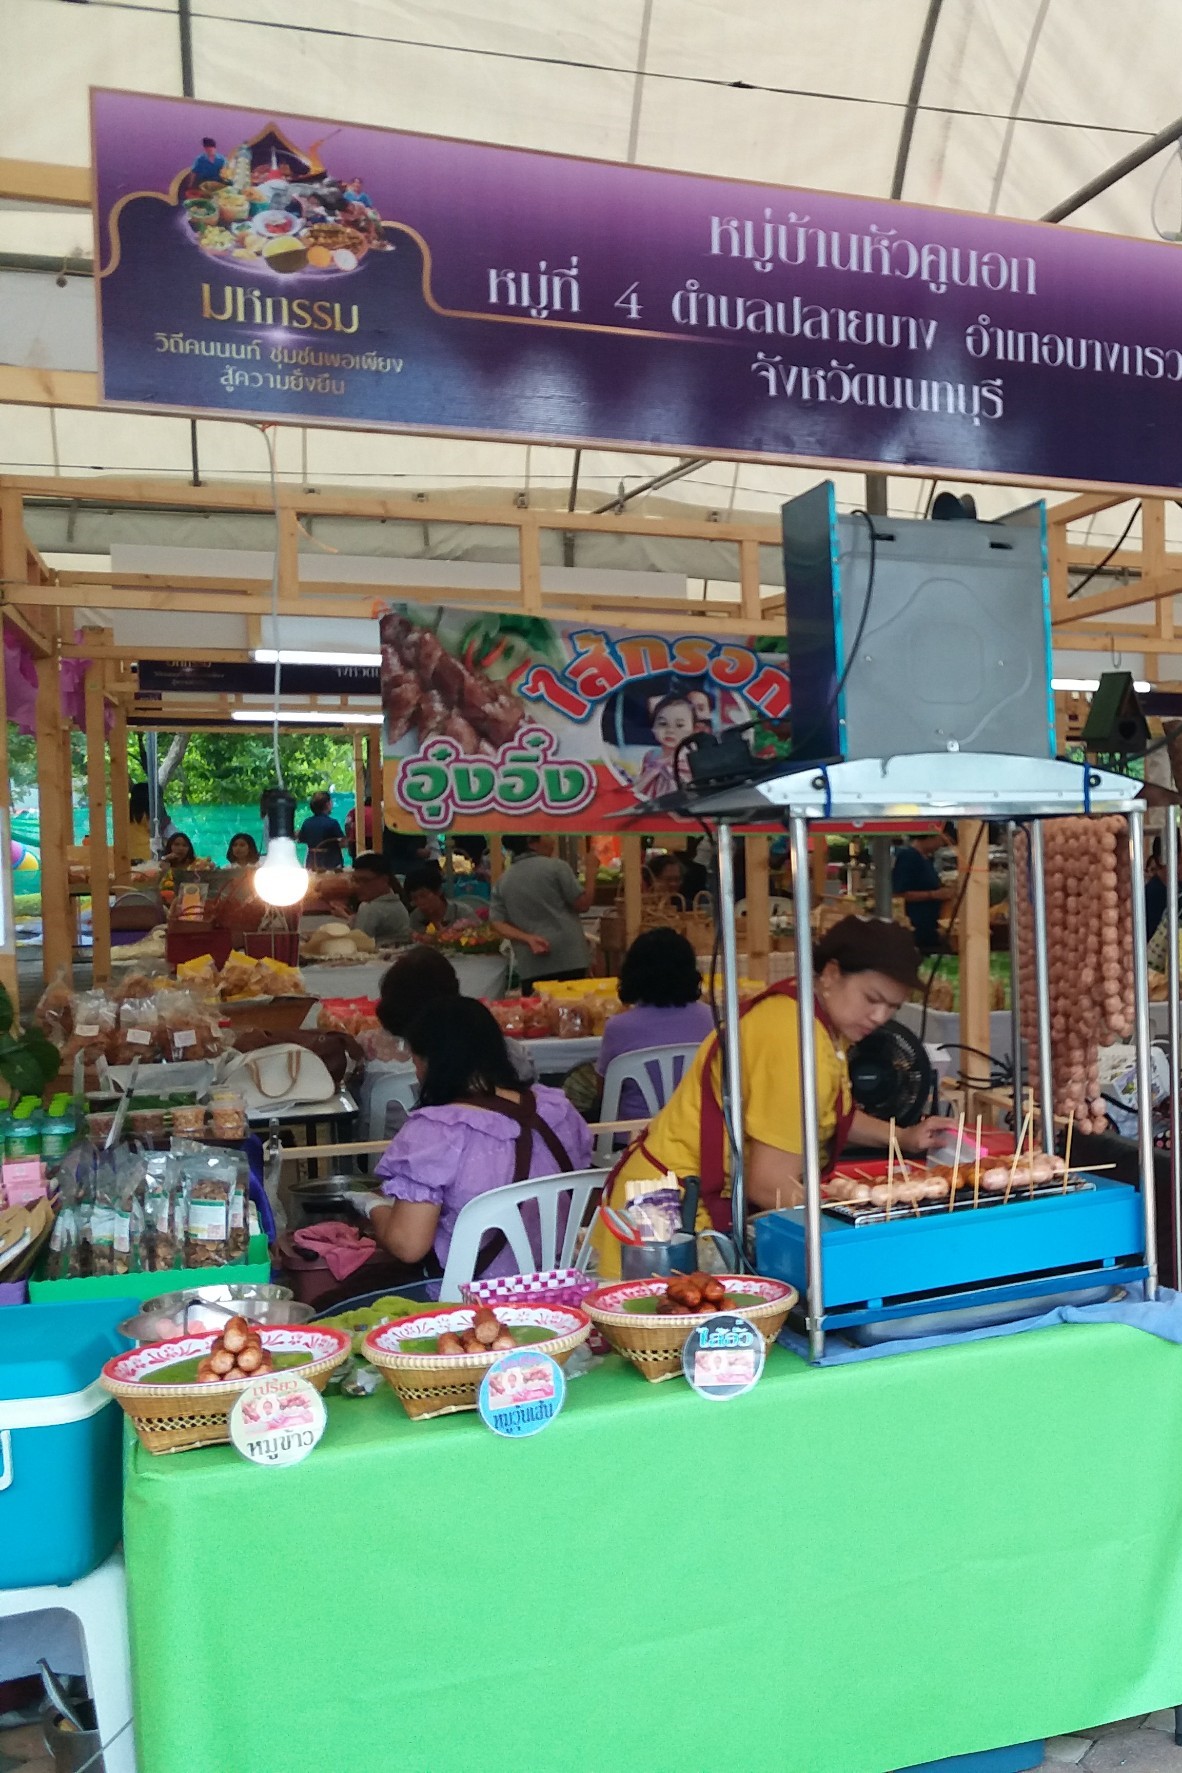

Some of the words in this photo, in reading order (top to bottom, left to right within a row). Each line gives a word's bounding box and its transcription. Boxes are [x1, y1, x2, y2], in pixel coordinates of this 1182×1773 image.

[710, 207, 1036, 294] หมู่บ้านหัวคูนอก
[201, 283, 359, 334] มหกรรม
[488, 256, 580, 318] หมู่ที่
[613, 281, 644, 319] 4
[671, 279, 938, 350] ตำบลปลายบาง
[154, 332, 262, 361] วิถีคนนนท์
[269, 346, 404, 373] ชุมชนพอเพียง
[751, 351, 1004, 427] จังหวัดนนทบุรี
[246, 1429, 314, 1460] หมูข้าว
